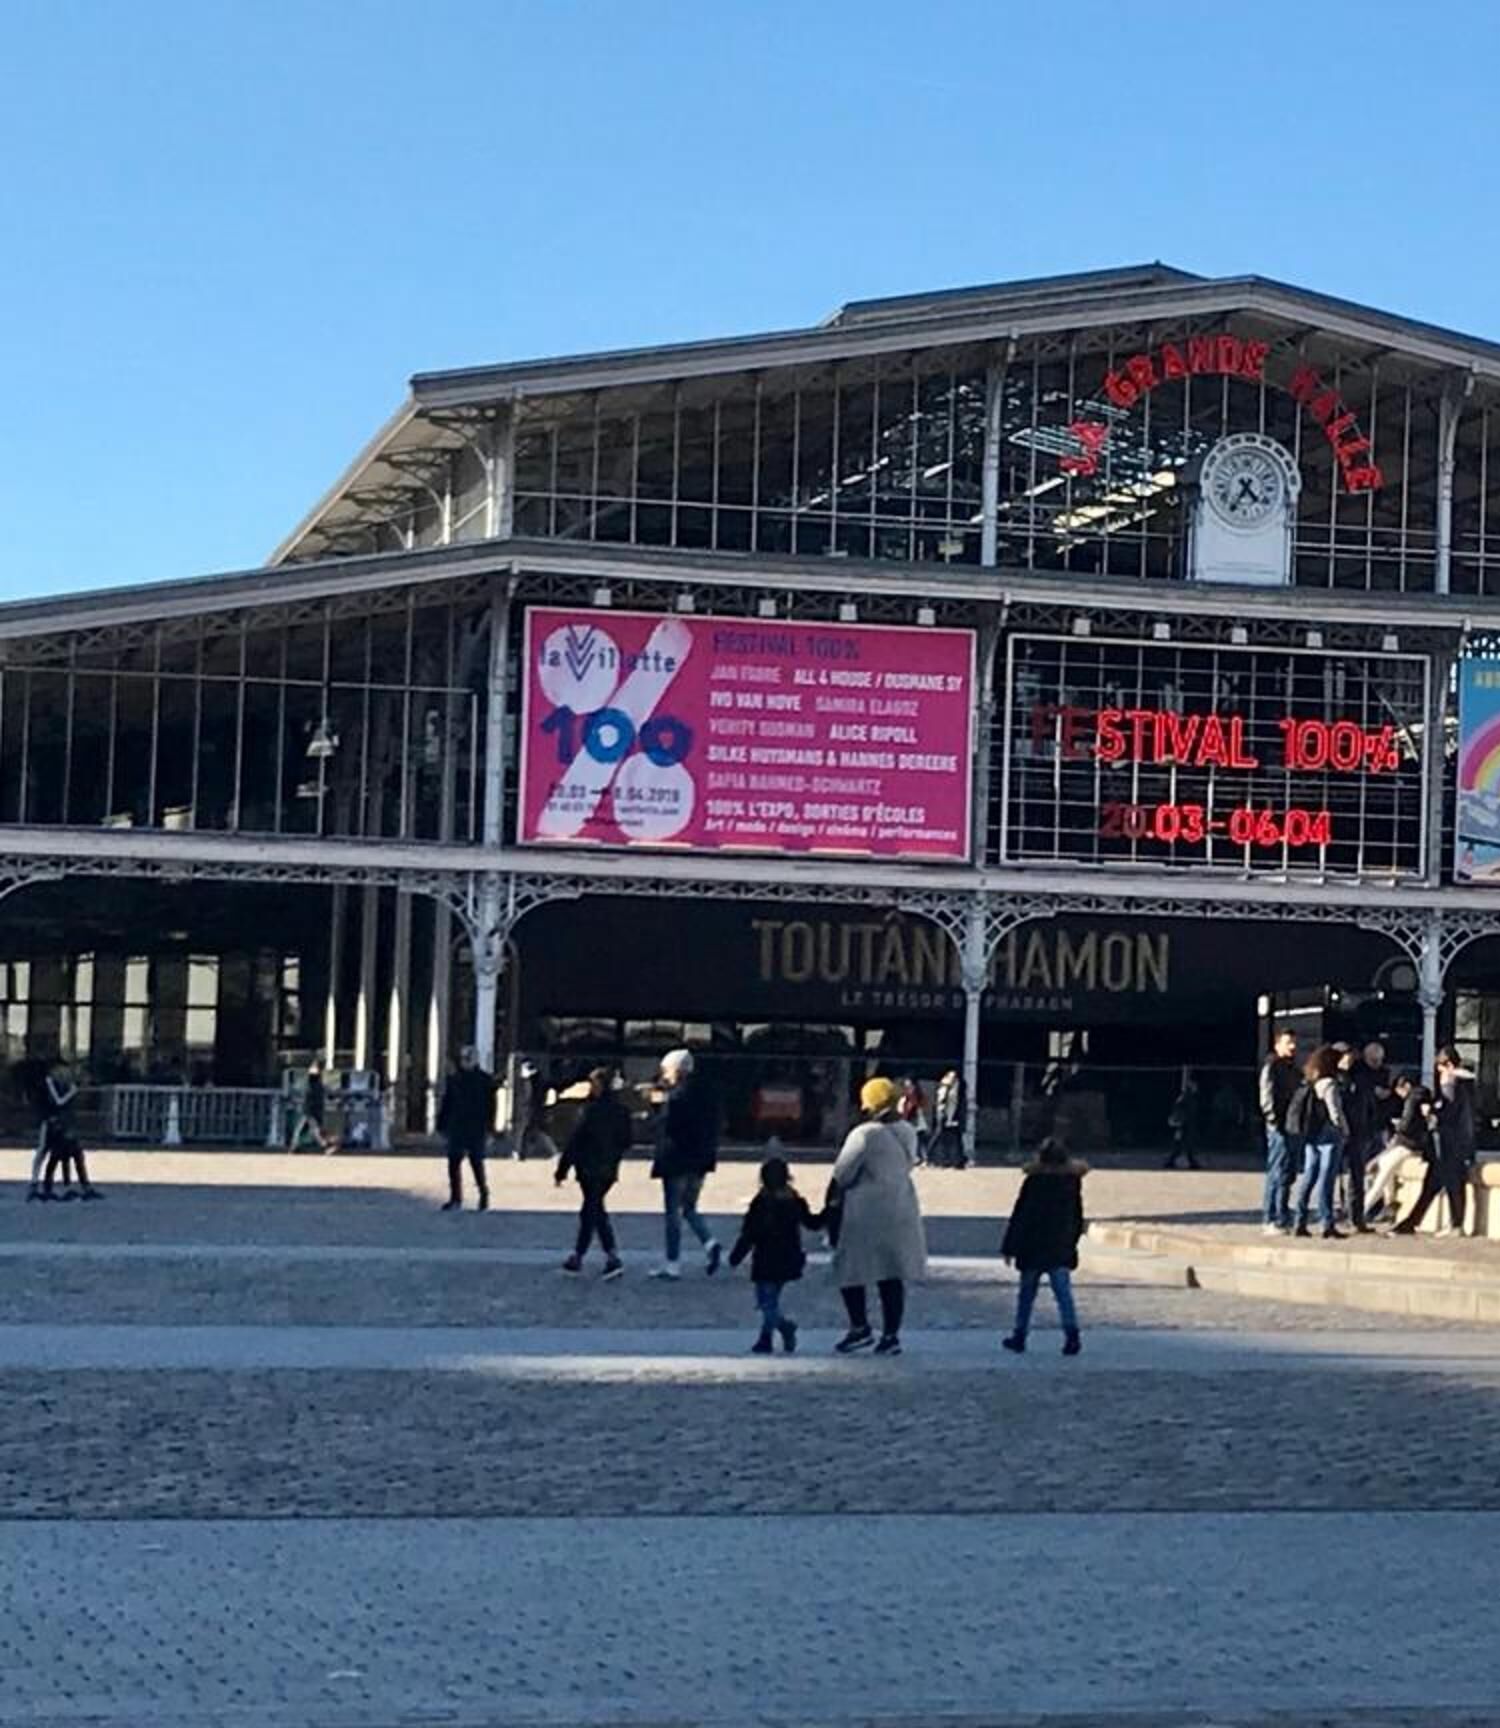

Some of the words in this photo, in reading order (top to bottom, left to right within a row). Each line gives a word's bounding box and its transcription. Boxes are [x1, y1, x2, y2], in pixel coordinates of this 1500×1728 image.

[1105, 335, 1271, 407] GRANDE
[1290, 366, 1384, 493] HALLE
[794, 669, 817, 685] ALL
[736, 693, 763, 709] VAN
[539, 704, 694, 768] 100
[829, 723, 868, 741] ALICE
[1031, 703, 1258, 770] FESTIVAL
[1280, 717, 1400, 774] 100%
[803, 803, 859, 821] SORTIES
[751, 911, 1169, 993] TOUTÂNHAMON
